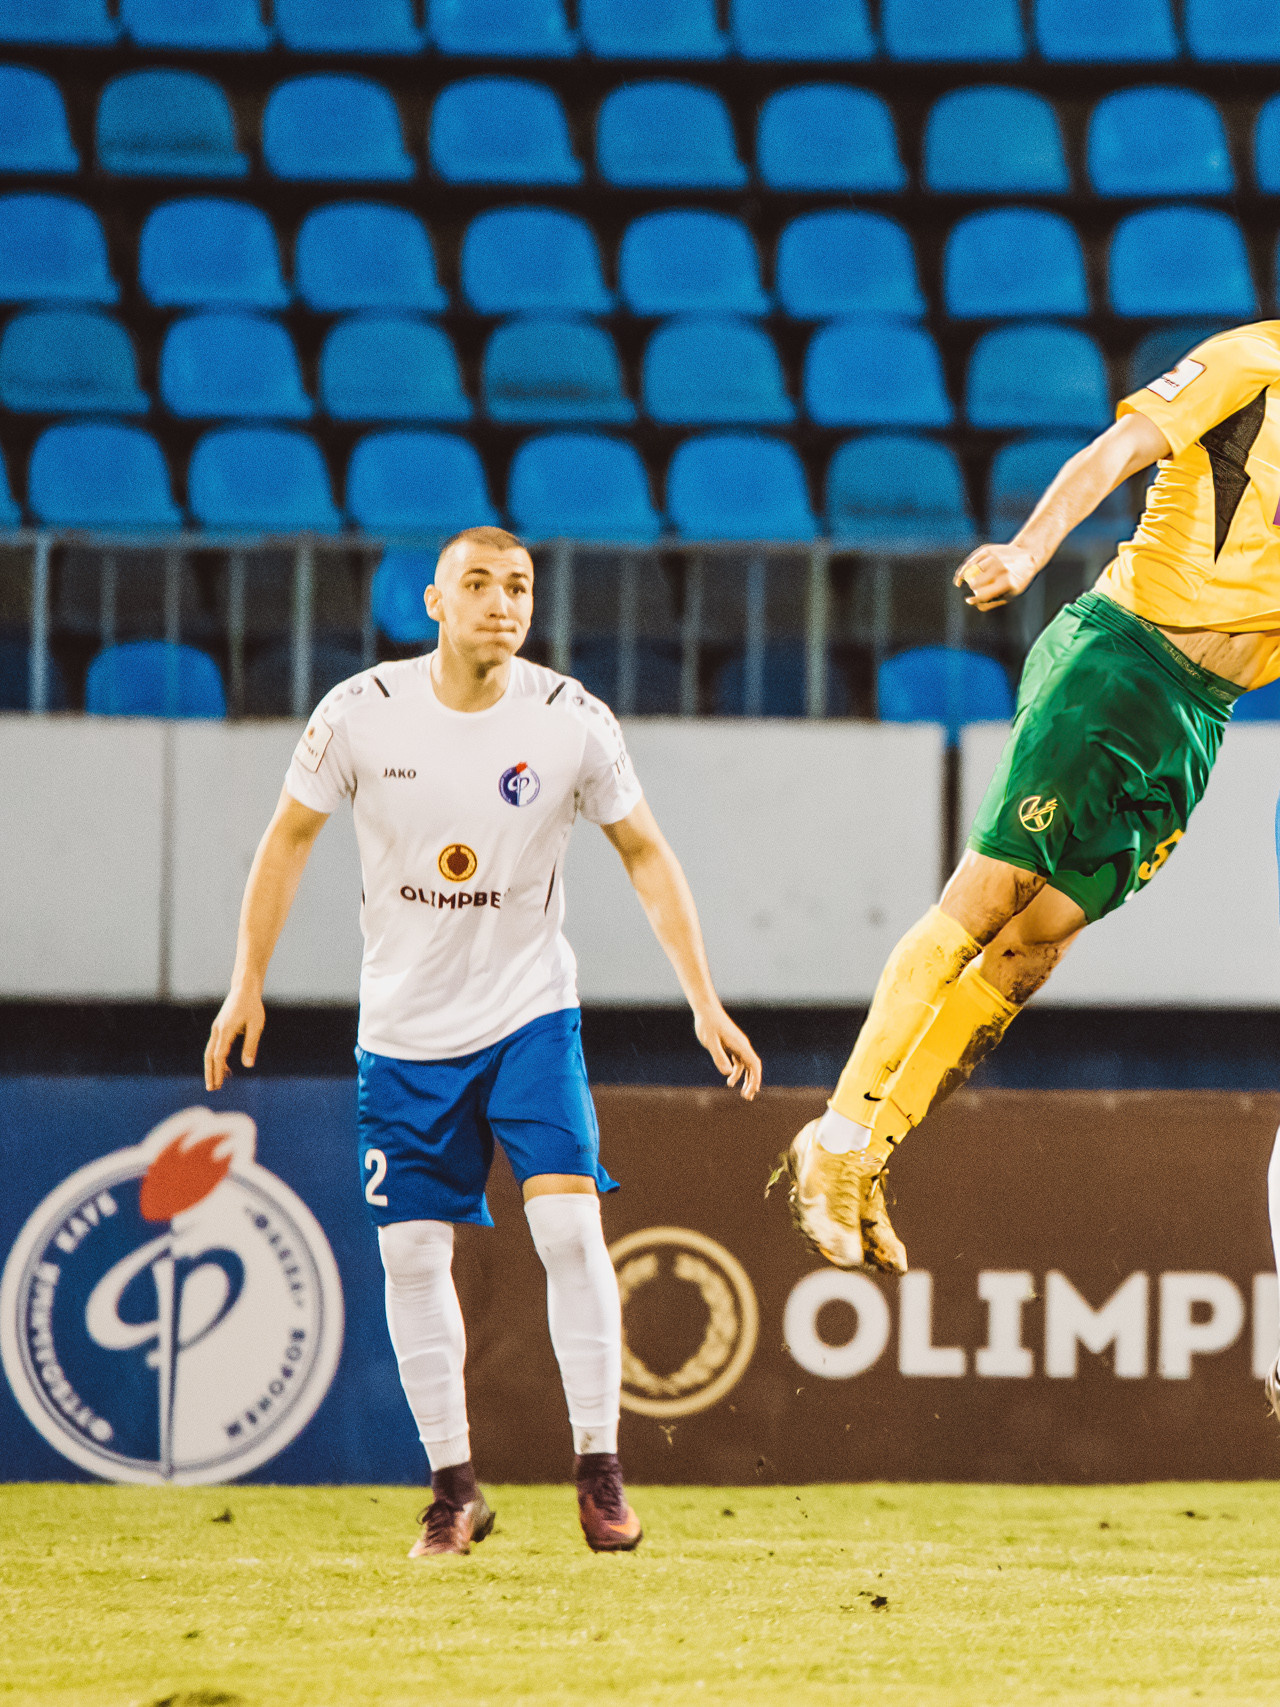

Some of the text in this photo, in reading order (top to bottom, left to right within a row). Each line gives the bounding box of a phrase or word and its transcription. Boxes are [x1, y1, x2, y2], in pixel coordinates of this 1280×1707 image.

[383, 767, 417, 779] JAKO
[400, 885, 511, 910] OLIMPBE
[364, 1148, 389, 1207] 2
